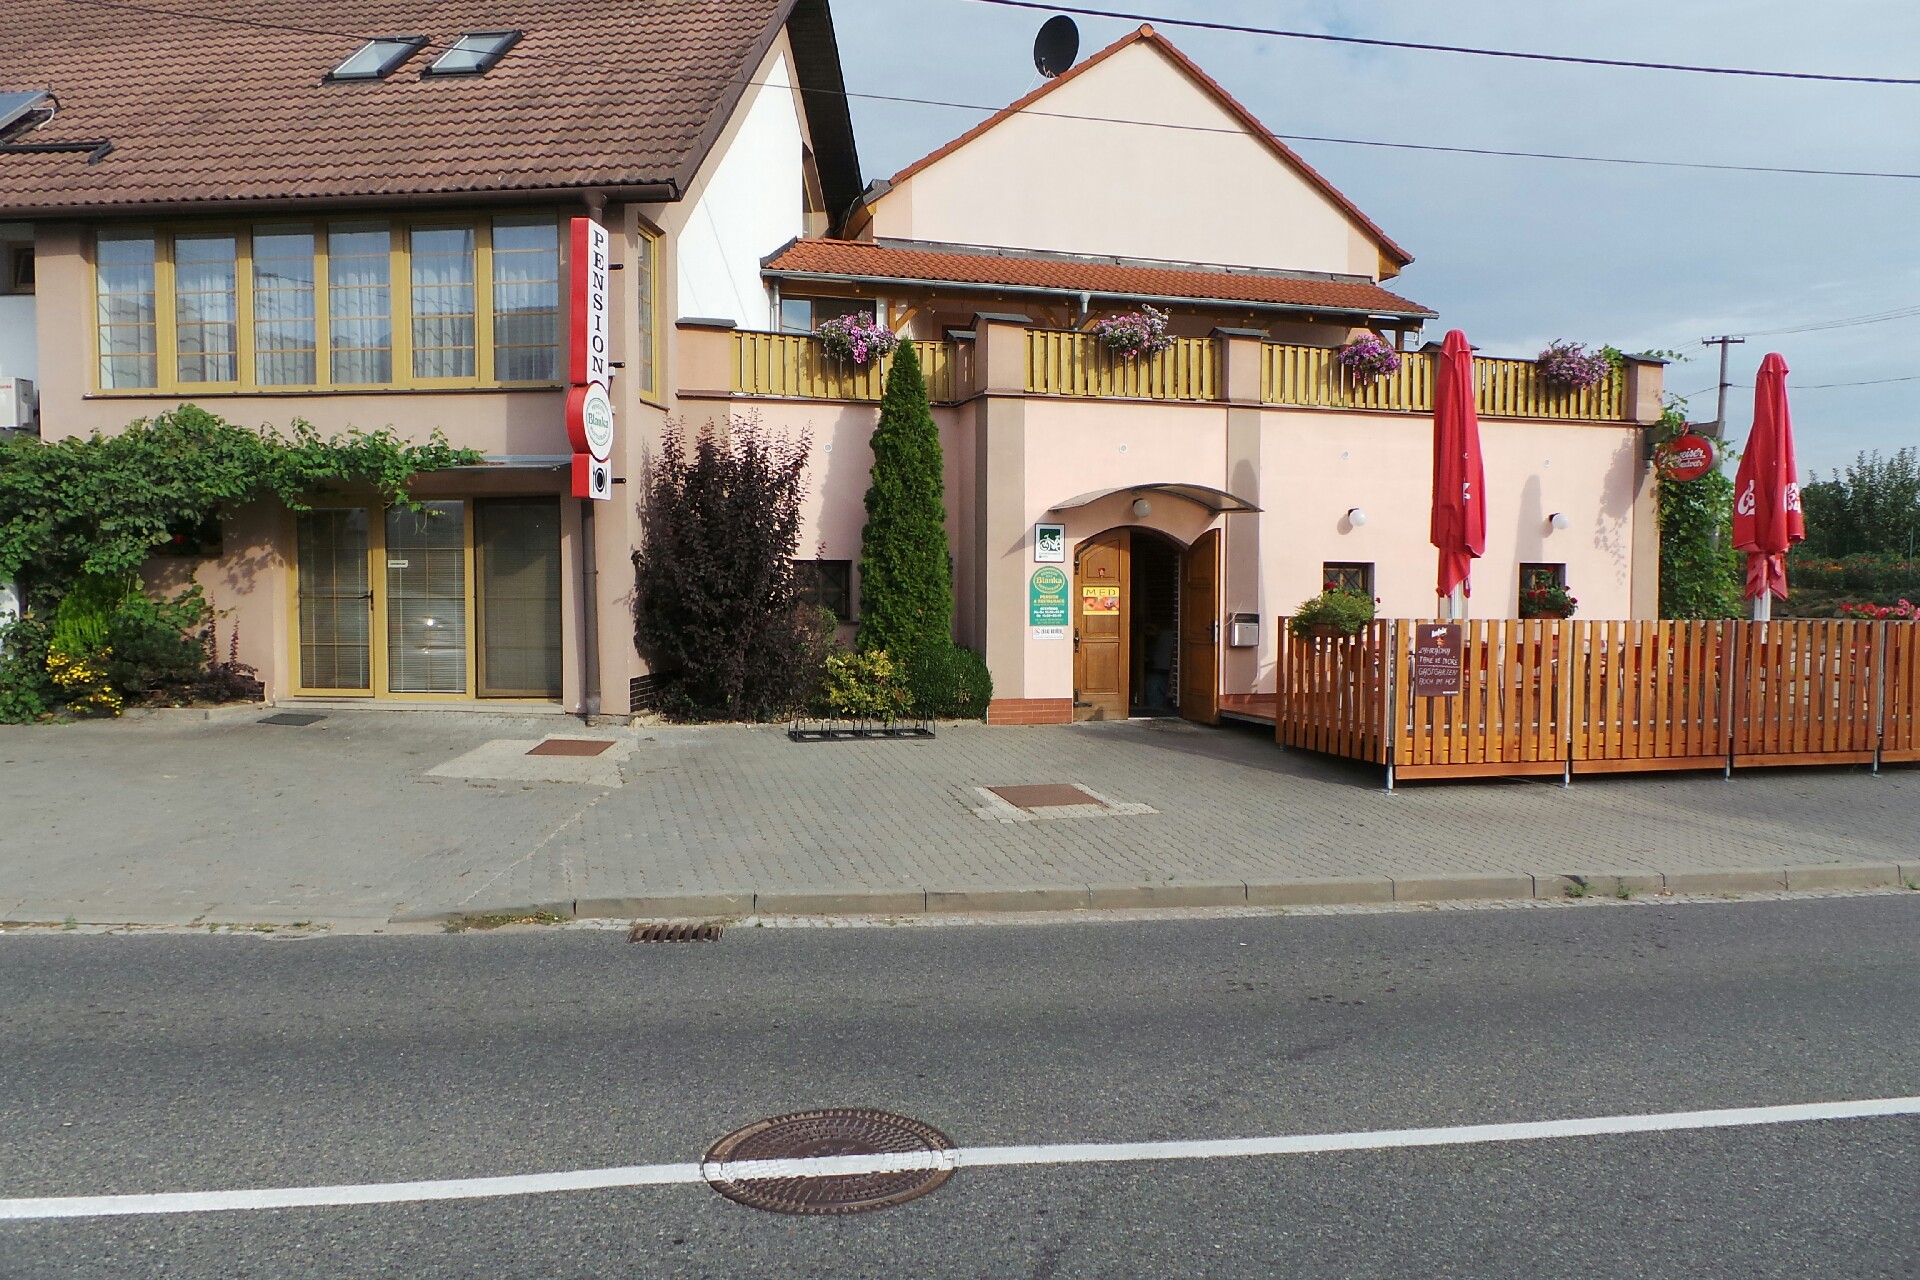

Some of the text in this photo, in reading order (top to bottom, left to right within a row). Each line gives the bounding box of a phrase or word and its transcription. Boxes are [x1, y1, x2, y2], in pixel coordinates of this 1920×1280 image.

[592, 229, 605, 375] PENSION
[588, 413, 609, 429] Blanka
[1036, 576, 1062, 584] Blanka
[1418, 667, 1459, 677] GASTGARTEN
[1445, 678, 1456, 686] HOF
